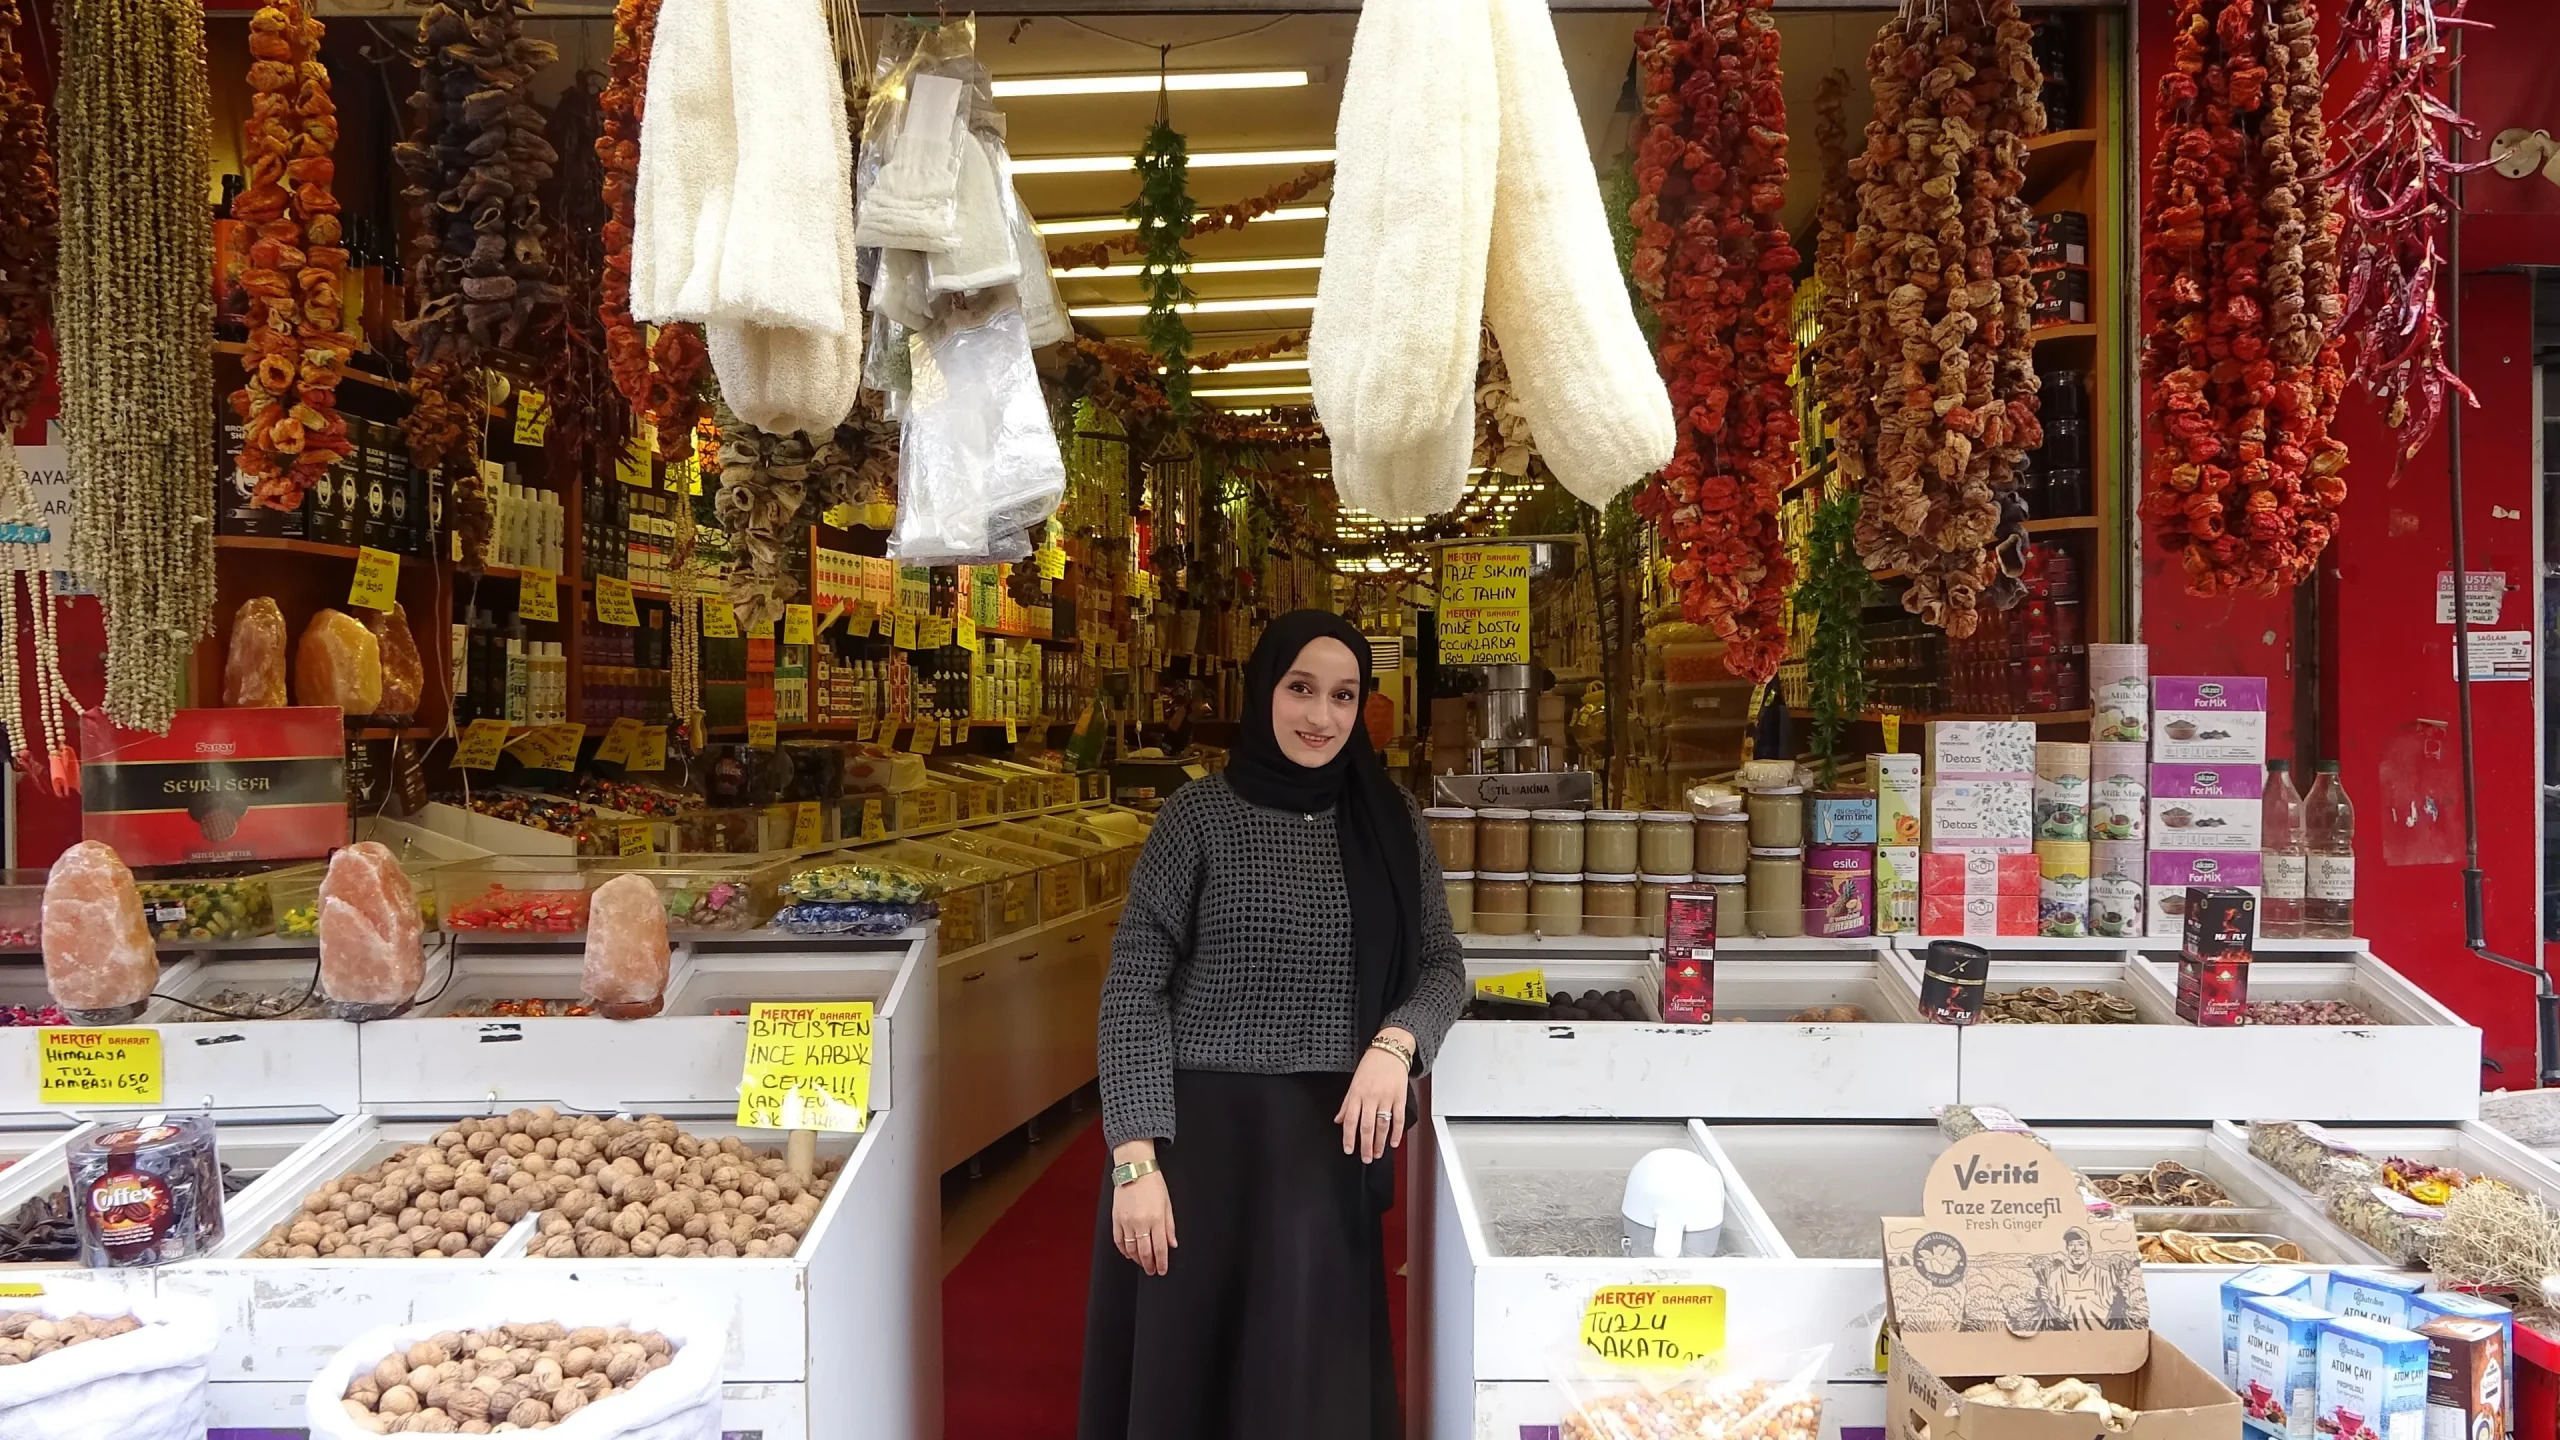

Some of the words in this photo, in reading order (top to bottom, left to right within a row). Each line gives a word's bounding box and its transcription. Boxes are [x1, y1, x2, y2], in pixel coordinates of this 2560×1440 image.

[1448, 552, 1482, 564] MERTAY
[1445, 564, 1478, 582] TAZE
[1483, 564, 1526, 578] SIKIM
[1446, 609, 1482, 620] MERTAY
[1487, 610, 1520, 618] BAHARAT
[1478, 621, 1520, 634] DOSTU
[226, 778, 270, 791] SEFA
[2095, 886, 2112, 894] Milk
[761, 1009, 815, 1024] MERTAY
[820, 1012, 861, 1020] BAHARAT
[50, 1034, 102, 1048] MERTAY
[108, 1037, 150, 1045] BAHARAT
[118, 1073, 148, 1088] 650
[1942, 1199, 1984, 1215] Taze
[1991, 1198, 2062, 1218] Zencefil
[1966, 1218, 2000, 1230] Fresh
[2002, 1218, 2042, 1232] Ginger
[1594, 1292, 1656, 1309] MERTAY
[1662, 1295, 1713, 1305] BAHARAT
[2344, 1307, 2367, 1318] ATOM
[2247, 1335, 2263, 1349] ATOM
[2264, 1342, 2279, 1356] ÇAYI
[2332, 1359, 2351, 1375] ATOM
[2354, 1366, 2372, 1381] ÇAYI
[2393, 1371, 2410, 1382] ATOM
[2411, 1369, 2424, 1382] ÇAYI
